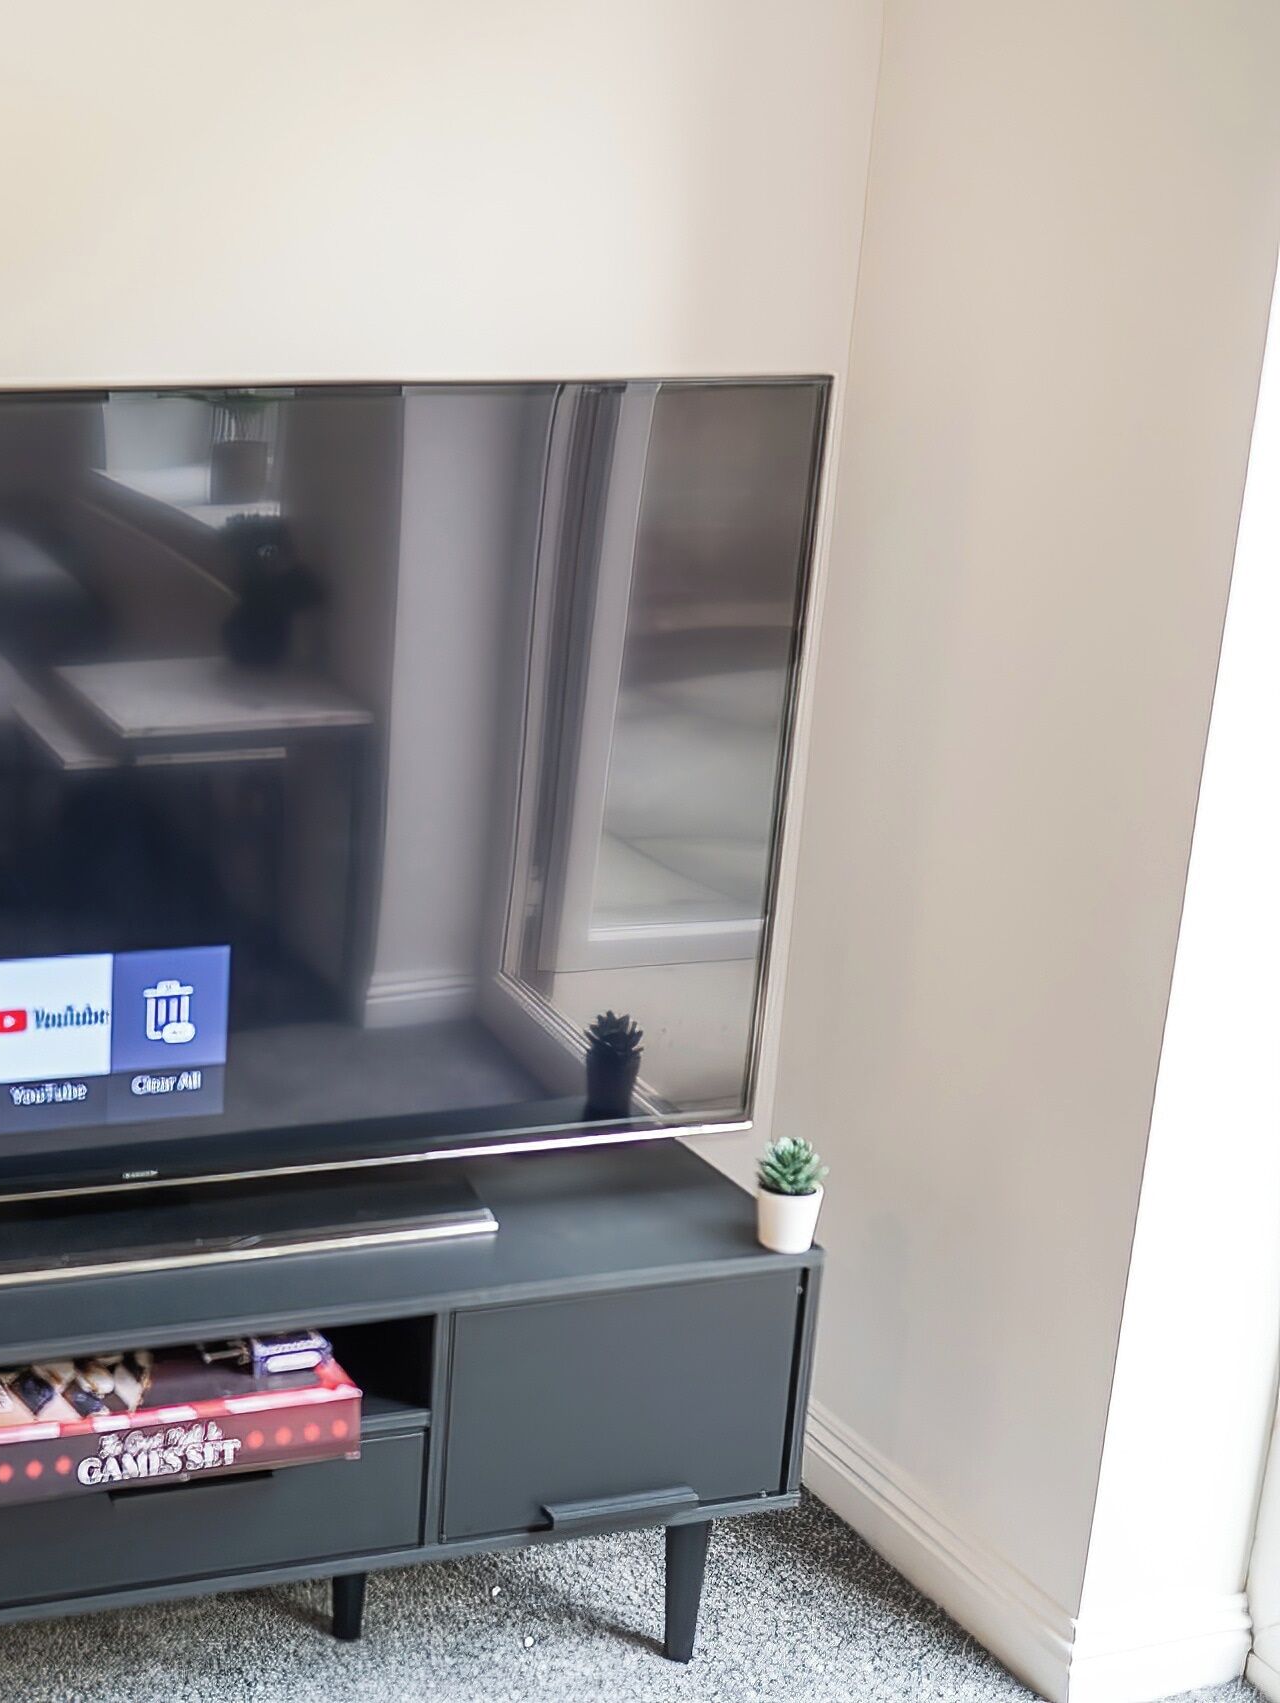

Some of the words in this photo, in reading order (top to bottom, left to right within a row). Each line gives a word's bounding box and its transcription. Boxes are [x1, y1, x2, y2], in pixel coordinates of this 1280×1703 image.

[10, 1082, 88, 1105] YouTube
[77, 1447, 183, 1485] GAMES
[185, 1438, 242, 1471] SET
